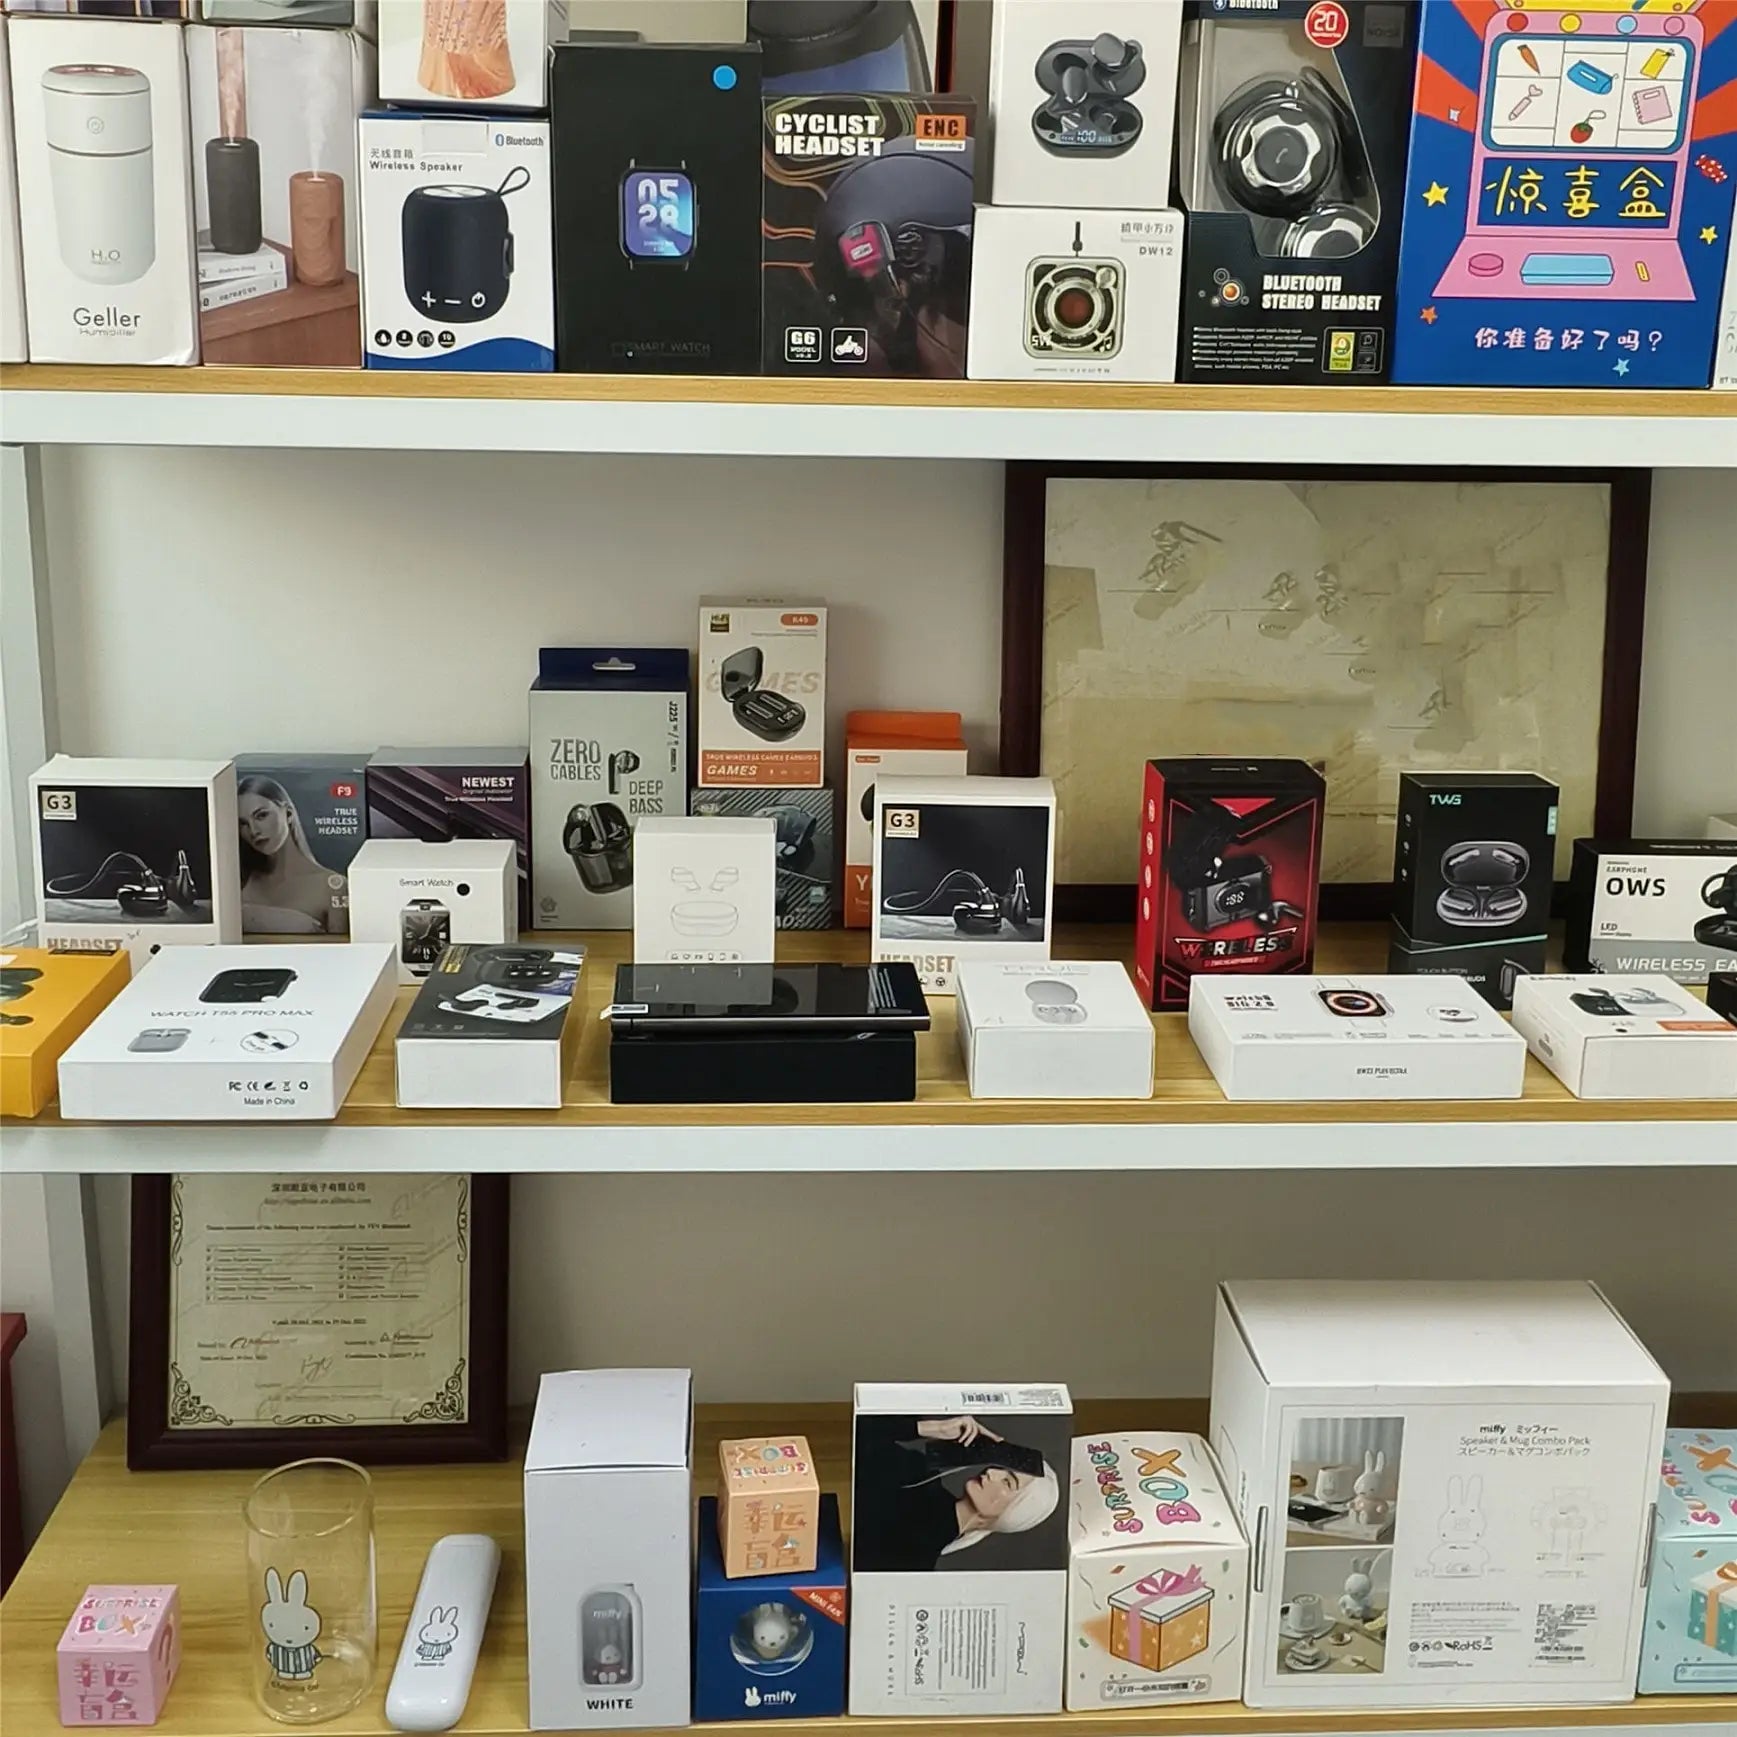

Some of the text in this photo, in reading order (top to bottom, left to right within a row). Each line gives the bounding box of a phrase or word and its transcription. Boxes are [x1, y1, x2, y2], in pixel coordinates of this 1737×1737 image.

[1314, 11, 1337, 32] 20
[775, 113, 880, 135] CYCLIST
[923, 119, 960, 137] ENC
[506, 135, 544, 146] Bluetooth
[775, 135, 885, 156] HEADSET
[370, 161, 463, 172] Wireless Speaker
[638, 178, 680, 204] 05
[1485, 164, 1667, 218] 惊喜盒
[1139, 246, 1173, 256] DW12
[1262, 274, 1342, 292] BLUETOOTH
[1262, 293, 1382, 312] STEREO HEADSET
[73, 307, 141, 327] Geller
[791, 331, 816, 345] G6
[706, 672, 820, 694] GMES
[550, 739, 601, 764] ZERO
[550, 764, 601, 781] CABLES
[707, 765, 758, 776] GAMES
[461, 776, 515, 788] NEWEST
[629, 780, 663, 795] DEEP
[337, 786, 352, 797] F9
[47, 794, 72, 810] G3
[629, 798, 663, 814] BASS
[334, 807, 357, 816] TRUE
[315, 816, 358, 826] WIRELESS
[890, 813, 915, 828] G3
[318, 826, 358, 835] HEADSET
[399, 878, 453, 887] Smart Watch
[1606, 877, 1666, 897] OWS
[1600, 923, 1618, 931] LED
[1616, 957, 1706, 971] WIRELESS
[151, 1009, 207, 1017] WATCH
[244, 1097, 295, 1105] Made in China
[1480, 1424, 1506, 1435] miffy
[1460, 1436, 1498, 1446] Speaker
[1510, 1436, 1530, 1446] Mug
[1532, 1436, 1566, 1445] Combo
[1568, 1436, 1591, 1445] Pack
[1087, 1441, 1144, 1533] SURPRISE
[1131, 1447, 1202, 1525] BOX
[82, 1598, 159, 1609] SURPRISE
[809, 1592, 827, 1607] MINI
[593, 1607, 623, 1620] miffy
[76, 1614, 148, 1637] BOX
[586, 1698, 634, 1710] WHITE
[764, 1690, 797, 1704] miffy
